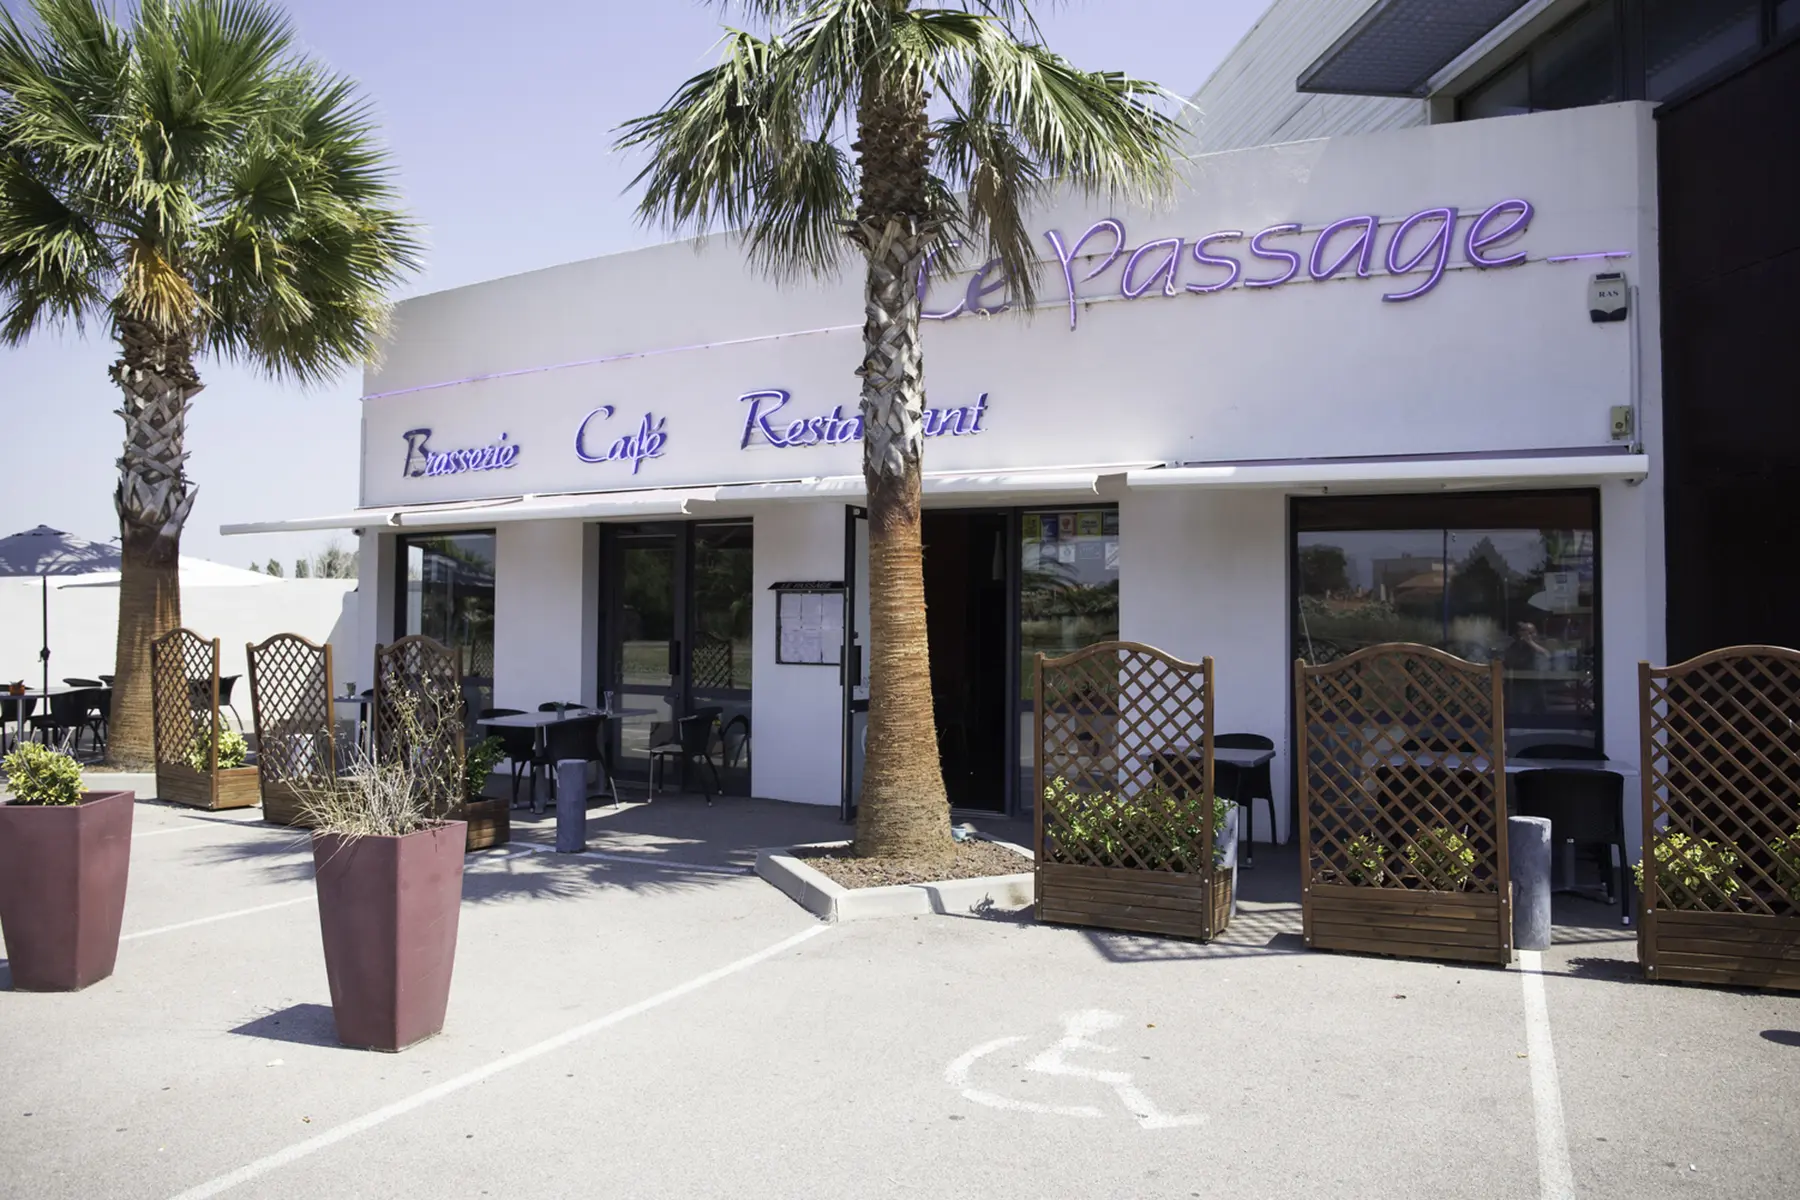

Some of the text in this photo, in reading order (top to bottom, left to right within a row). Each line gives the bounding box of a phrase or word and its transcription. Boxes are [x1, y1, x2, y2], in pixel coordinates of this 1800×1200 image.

[1043, 199, 1534, 332] Passage
[402, 389, 989, 477] Brasserie Café Restaant
